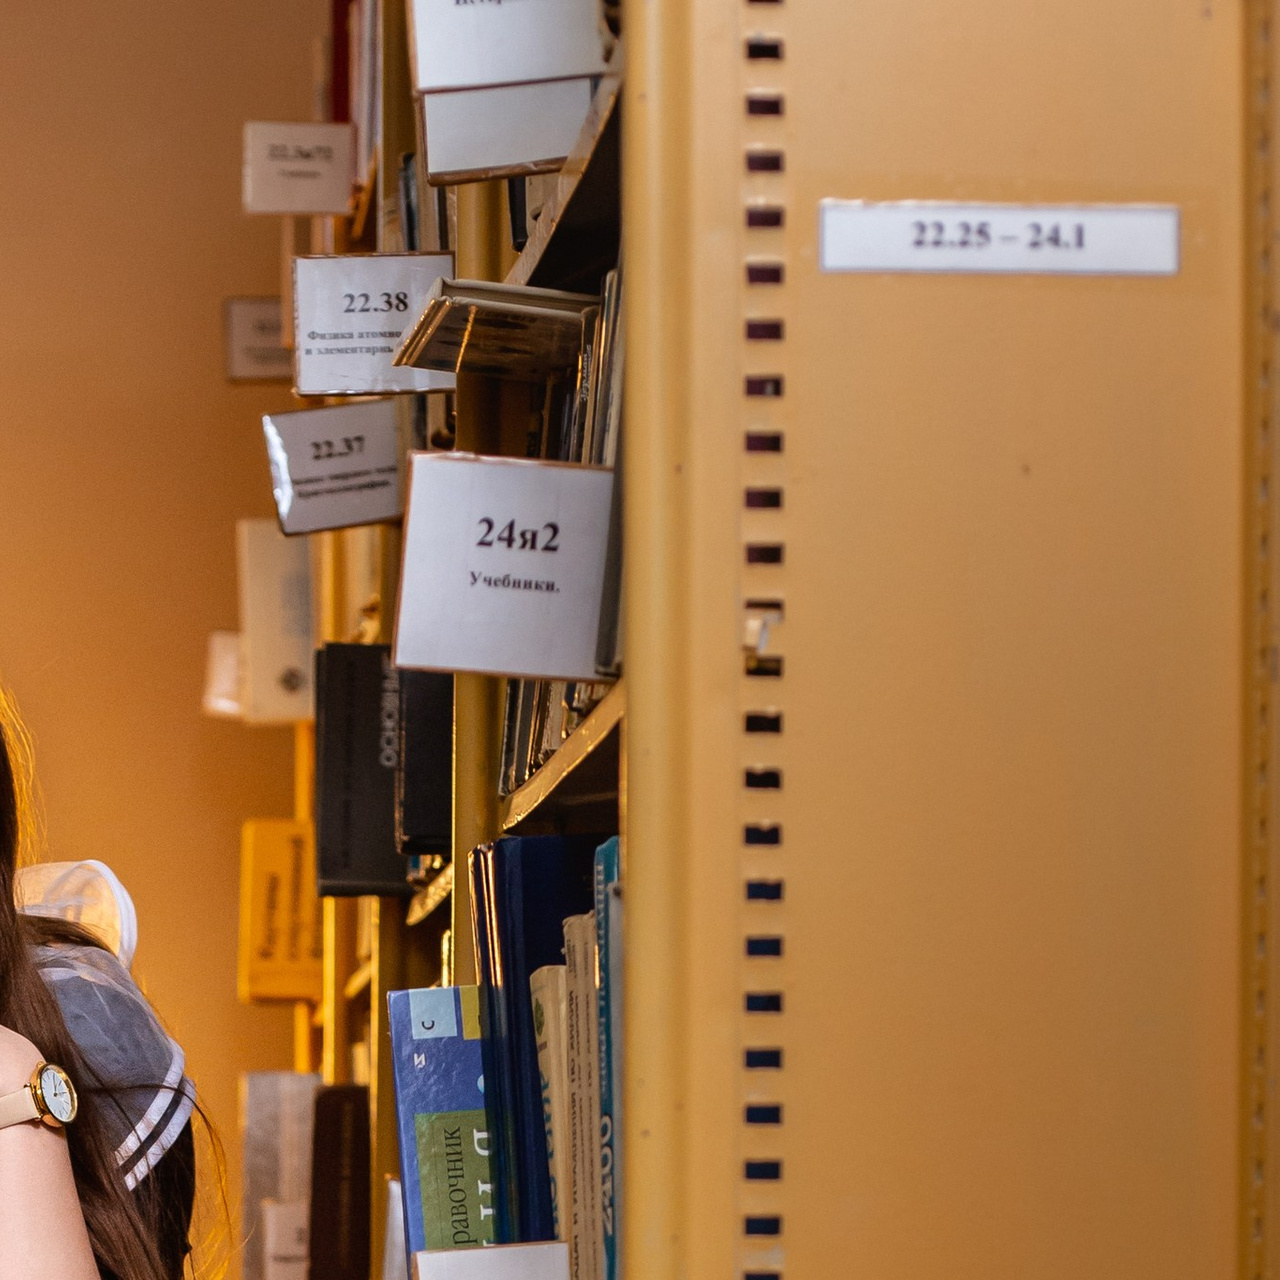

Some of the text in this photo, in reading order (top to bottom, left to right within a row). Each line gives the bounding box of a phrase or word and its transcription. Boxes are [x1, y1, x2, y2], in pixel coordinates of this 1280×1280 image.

[1027, 221, 1085, 249] 24.1
[343, 292, 409, 313] 22.38
[307, 331, 354, 341] Физика
[477, 517, 560, 552] 24я2
[470, 571, 560, 594] Учебники.
